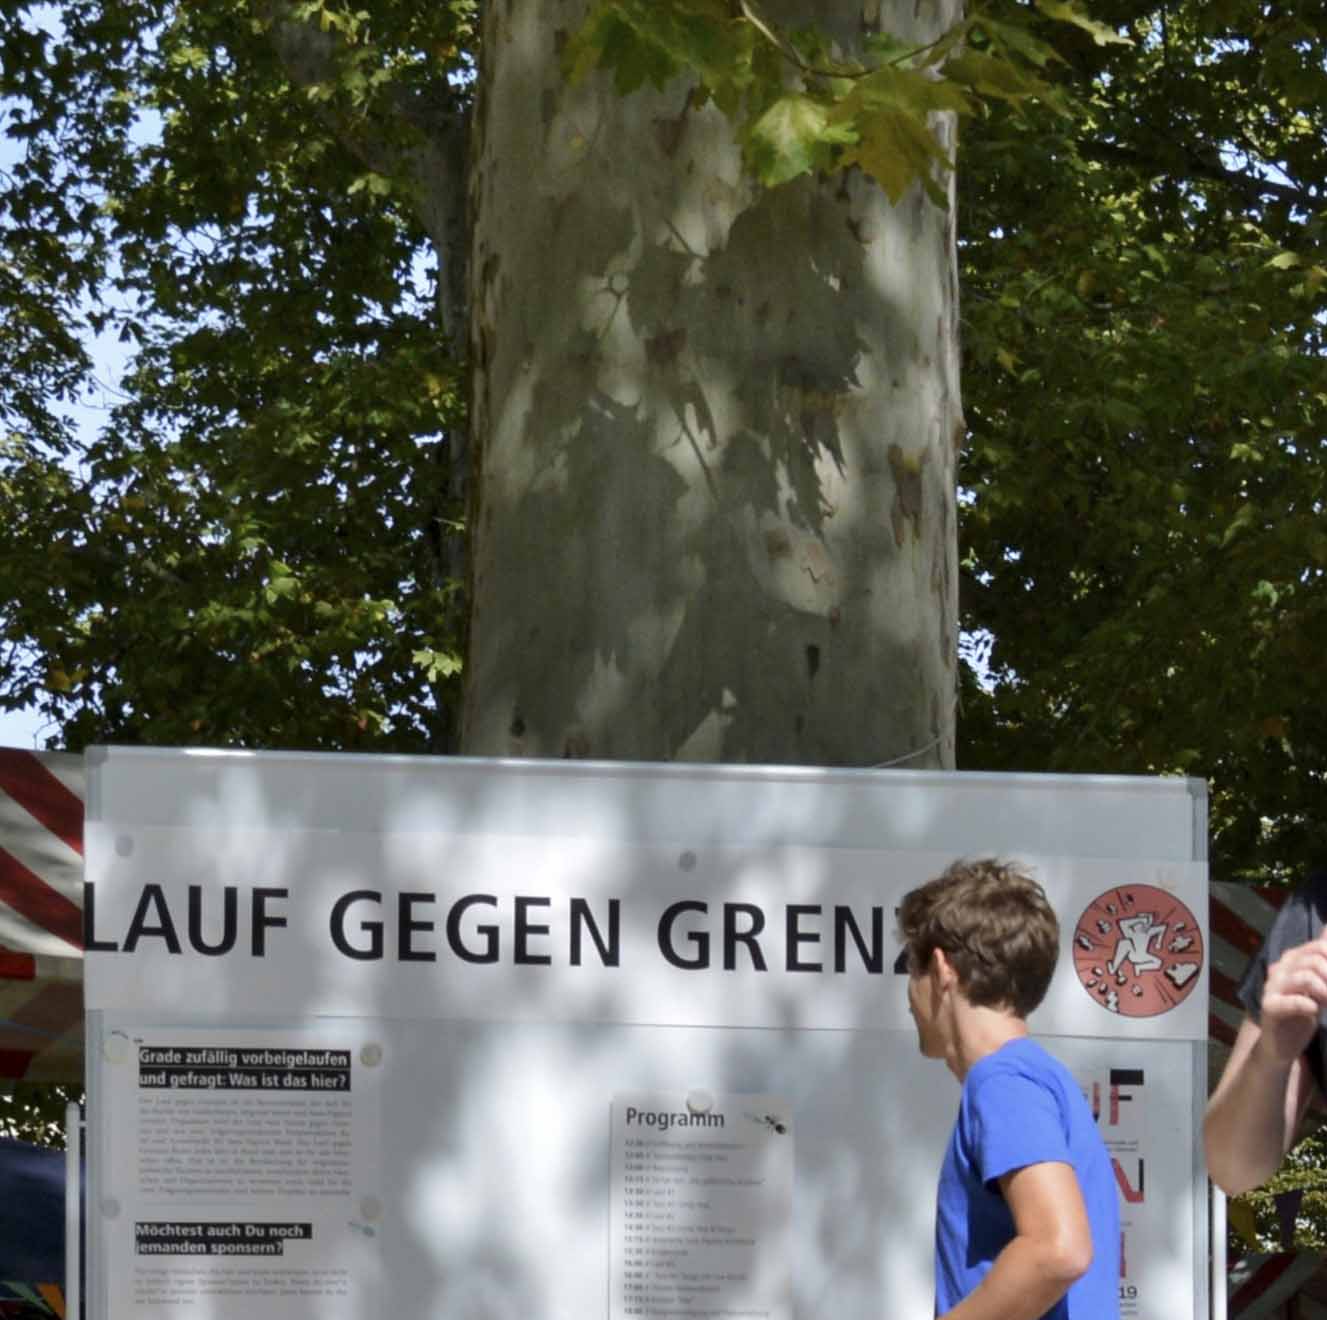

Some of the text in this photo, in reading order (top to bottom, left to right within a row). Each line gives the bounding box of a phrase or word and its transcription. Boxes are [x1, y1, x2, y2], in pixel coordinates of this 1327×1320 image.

[83, 881, 289, 958] LAUF
[328, 889, 621, 967] GEGEN
[139, 1049, 348, 1069] Grade zufällig vorbeigelaufen
[139, 1071, 167, 1086] und
[229, 1073, 258, 1087] Was
[261, 1074, 280, 1088] ist
[283, 1074, 308, 1088] das
[311, 1074, 347, 1089] hier?
[626, 1107, 725, 1131] Programm
[135, 1225, 304, 1239] Möchtest auch Du noch
[210, 1242, 284, 1256] sponsern?
